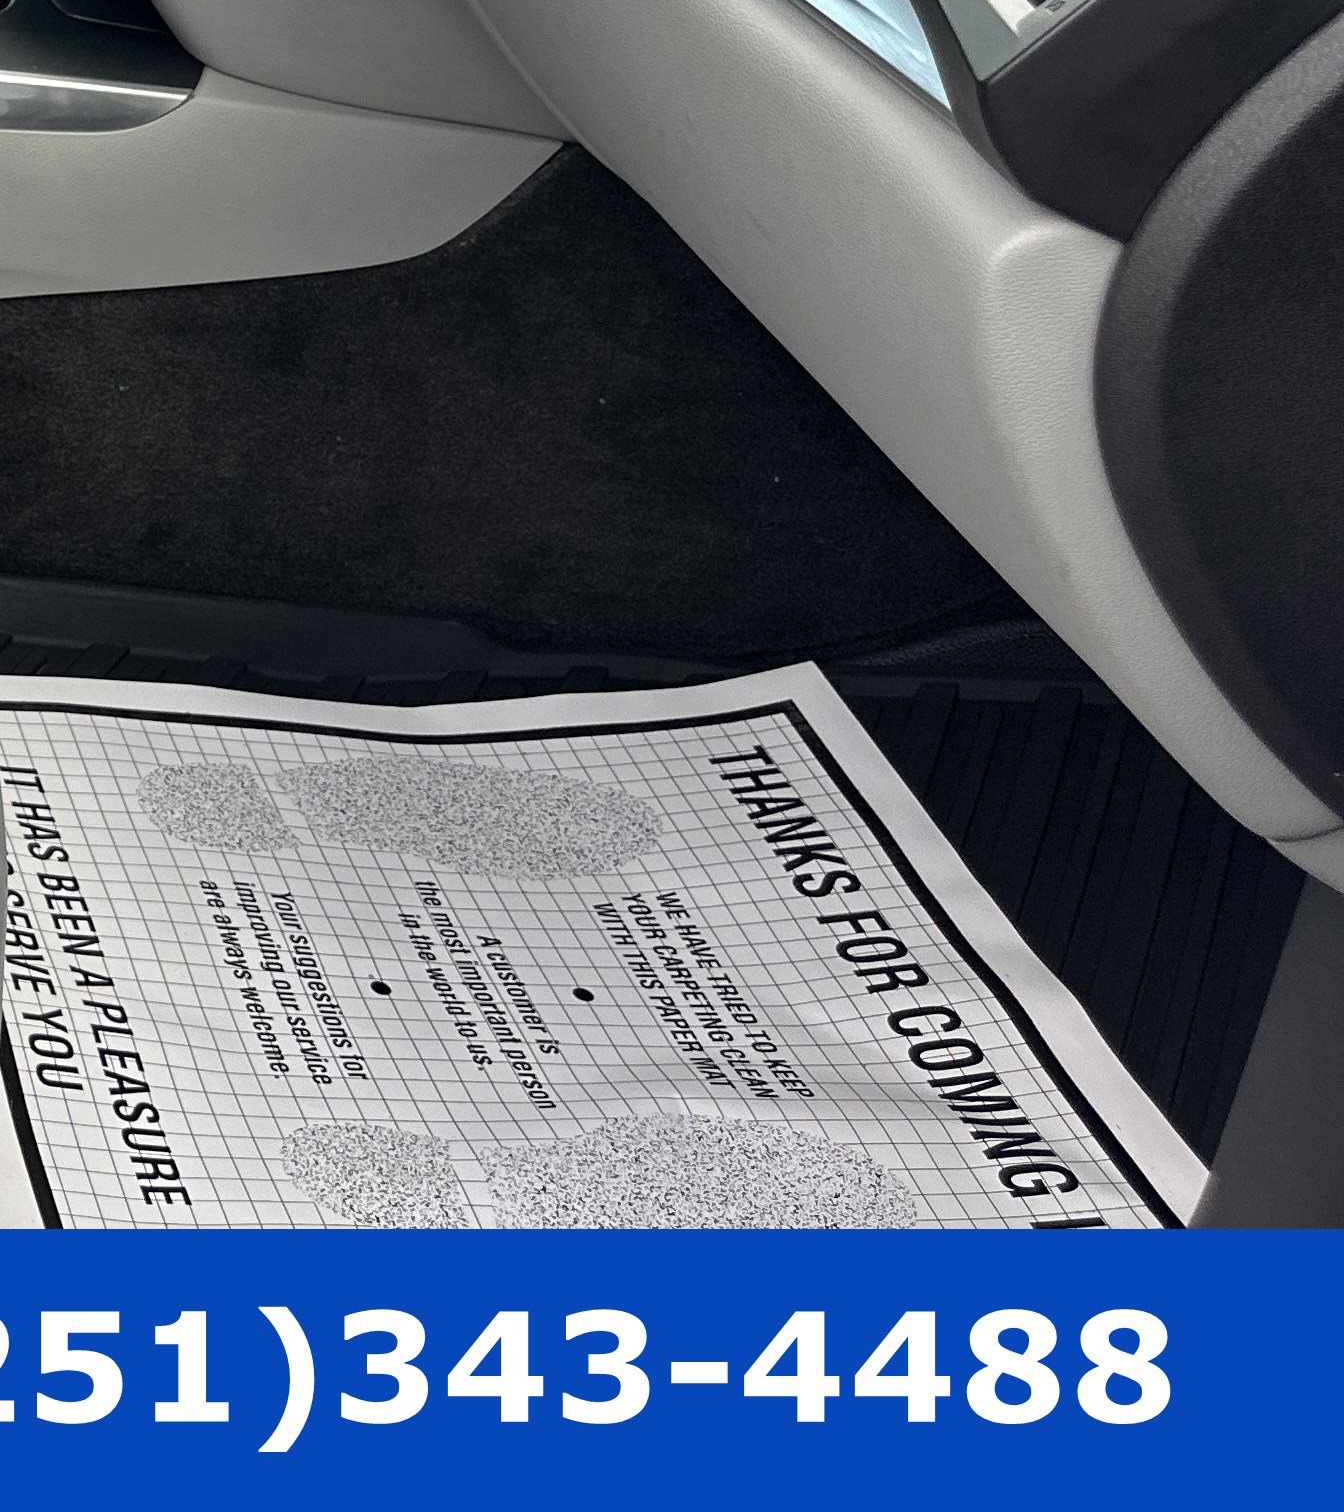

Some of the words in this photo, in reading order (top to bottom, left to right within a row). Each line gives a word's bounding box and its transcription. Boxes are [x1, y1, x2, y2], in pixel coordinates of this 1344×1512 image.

[0, 765, 45, 794] IT
[11, 801, 70, 863] HAS
[36, 872, 105, 957] BEEN
[398, 912, 421, 929] in
[409, 933, 436, 962] the
[476, 935, 502, 947] A
[69, 964, 115, 987] A
[199, 880, 226, 909] are
[213, 914, 252, 980] always
[240, 986, 290, 1080] welcome.
[233, 880, 285, 973] improving
[272, 979, 302, 1011] our
[287, 1015, 332, 1085] service
[271, 892, 302, 931] Your
[290, 933, 352, 1049] suggestions
[339, 1054, 368, 1080] for
[414, 880, 442, 907] the
[431, 911, 471, 955] most
[456, 959, 522, 1044] important
[500, 1048, 557, 1109] person
[426, 967, 472, 1016] world
[486, 952, 548, 1033] customer
[593, 902, 637, 946] WITH
[623, 951, 663, 990] THIS
[650, 995, 704, 1052] PAPER
[689, 1057, 736, 1089] MAT
[621, 893, 667, 939] YOUR
[653, 945, 734, 1043] CARPETING
[720, 1048, 779, 1099] CLEAN
[656, 891, 691, 919] WE
[674, 924, 722, 969] HAVE
[707, 973, 758, 1025] TRIED
[745, 1030, 778, 1053] TO
[763, 1059, 815, 1098] KEEP
[708, 744, 863, 899] THANKS
[816, 910, 931, 995] FOR
[887, 1005, 1081, 1199] COMING
[21, 1008, 84, 1091] YOU
[454, 1020, 478, 1038] to
[535, 1039, 560, 1055] is
[82, 999, 193, 1207] PLEASURE
